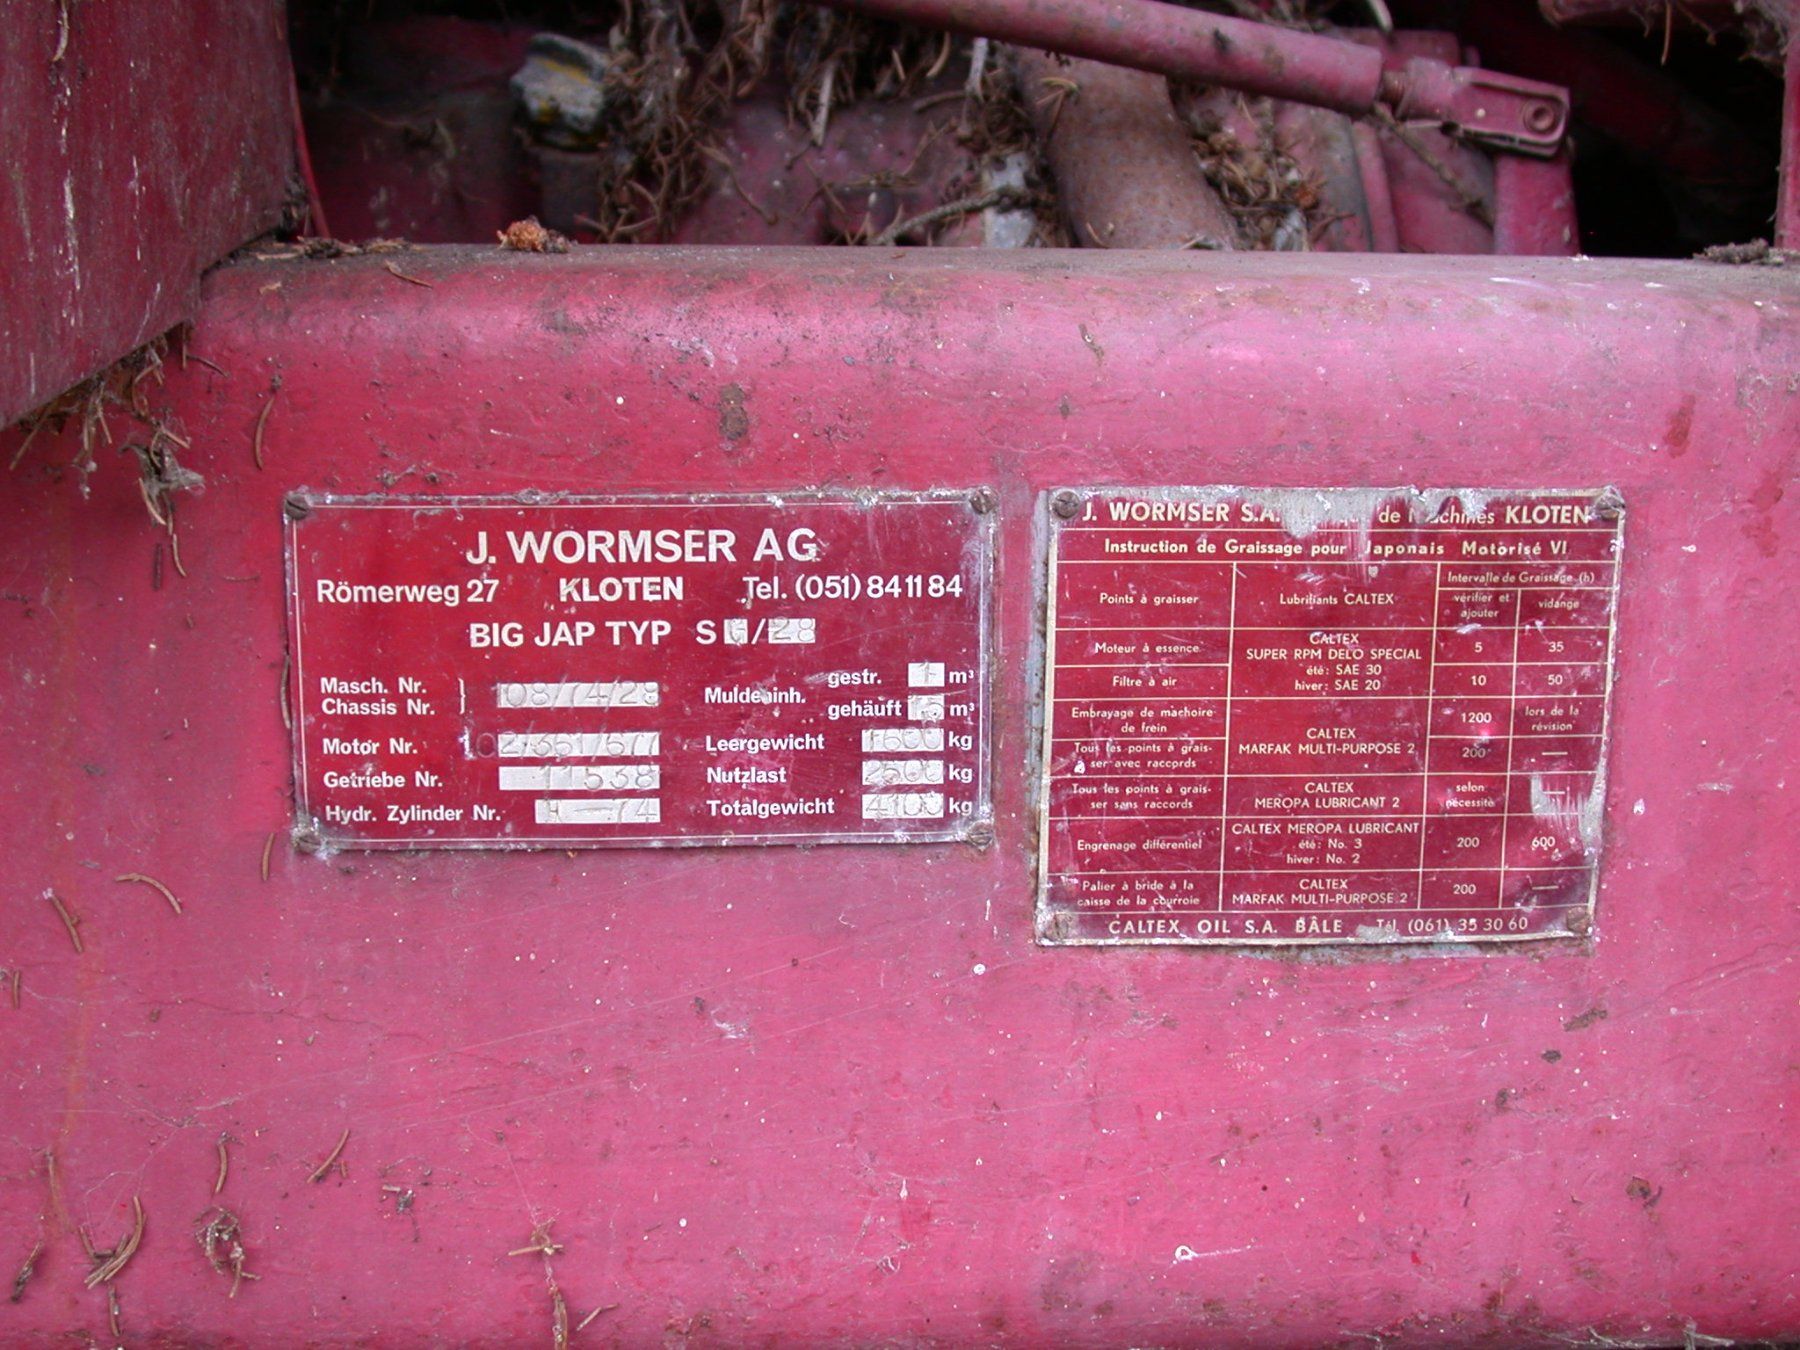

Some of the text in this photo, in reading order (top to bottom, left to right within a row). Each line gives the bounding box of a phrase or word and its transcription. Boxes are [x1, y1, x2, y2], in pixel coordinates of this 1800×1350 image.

[1082, 503, 1098, 521] J.
[1109, 502, 1230, 522] WORMSER
[1241, 503, 1281, 523] S.A.
[1378, 505, 1401, 523] de
[1505, 505, 1593, 525] KLOTEN
[466, 528, 818, 564] J. WORMSER AG
[1104, 538, 1568, 557] Instruction de Graissage pour Japonais Motorisé VI
[1447, 571, 1596, 586] Intervalle de Graissage (h)
[317, 579, 500, 606] Römerweg 27
[559, 576, 684, 602] KLOTEN
[742, 573, 861, 600] Tel. (051)
[1099, 592, 1199, 607] Points à graisser
[1280, 592, 1394, 605] Lubrifiants CALTEX
[1453, 592, 1510, 603] vérifier et
[1538, 596, 1580, 610] vidange
[1460, 608, 1499, 620] ajouter
[469, 620, 671, 647] BIG JAP TYP
[1309, 633, 1359, 645] CALTEX
[1095, 642, 1200, 654] Moteur à essence
[1246, 648, 1422, 660] SUPER RPM DELO SPECIAL
[1474, 642, 1483, 653] 5
[1548, 642, 1564, 653] 35
[1335, 665, 1360, 676] SAE
[1366, 664, 1383, 676] 30
[827, 669, 882, 687] gestr.
[1112, 675, 1178, 687] Filtre à air
[1471, 674, 1487, 686] 10
[1547, 674, 1563, 686] 50
[320, 677, 427, 693] Masch. Nr.
[1334, 679, 1359, 691] SAE
[1364, 679, 1381, 691] 20
[704, 687, 806, 704] Muldeninh.
[321, 699, 436, 715] Chassis Nr.
[827, 700, 903, 720] gehäuft
[1525, 705, 1580, 716] lors de la
[1071, 707, 1155, 721] Embrayage de
[1461, 711, 1493, 724] 1200
[1121, 721, 1168, 733] de frein
[1531, 720, 1574, 732] révision
[948, 731, 973, 750] kg
[1306, 728, 1357, 740] CALTEX
[322, 737, 418, 755] Motor Nr.
[705, 734, 825, 753] Leergewicht
[1074, 741, 1213, 756] Tous les points à grais-
[1238, 742, 1416, 755] MARFAK MULTI-PURPOSE 2
[1462, 746, 1487, 759] 200
[1090, 757, 1197, 769] ser avec raccords
[323, 770, 443, 788] Getriebe Nr.
[706, 766, 787, 784] Nutzlast
[948, 764, 973, 783] kg
[1072, 782, 1212, 796] Tous les points à grais-
[1304, 782, 1354, 794] CALTEX
[1456, 781, 1485, 792] selon
[706, 798, 835, 816] Totalgewicht
[948, 797, 973, 817] kg
[1091, 798, 1194, 809] ser sans raccords
[1254, 796, 1400, 809] MEROPA LUBRICANT 2
[325, 804, 502, 824] Hydr. Zylinder Nr.
[1231, 821, 1420, 835] CALTEX MEROPA LUBRICANT
[1077, 838, 1202, 852] Engrenage différentiel
[1328, 837, 1348, 849] No.
[1354, 837, 1363, 849] 3
[1456, 836, 1480, 848] 200
[1531, 835, 1556, 847] 600
[1326, 853, 1346, 864] No.
[1352, 853, 1361, 864] 2
[1082, 879, 1195, 892] Palier à bride à la
[1299, 878, 1349, 890] CALTEX
[1452, 883, 1477, 895] 200
[1077, 895, 1201, 907] caisse de la courroie
[1232, 892, 1409, 905] MARFAK MULTI-PURPOSE 2
[1108, 919, 1181, 934] CALTEX
[1197, 919, 1231, 934] OIL
[1244, 919, 1278, 934] S.A.
[1295, 916, 1343, 934] BÂLE
[1407, 917, 1450, 934] (061)
[1457, 918, 1478, 932] 35
[1483, 918, 1504, 931] 30
[1508, 916, 1529, 930] 60
